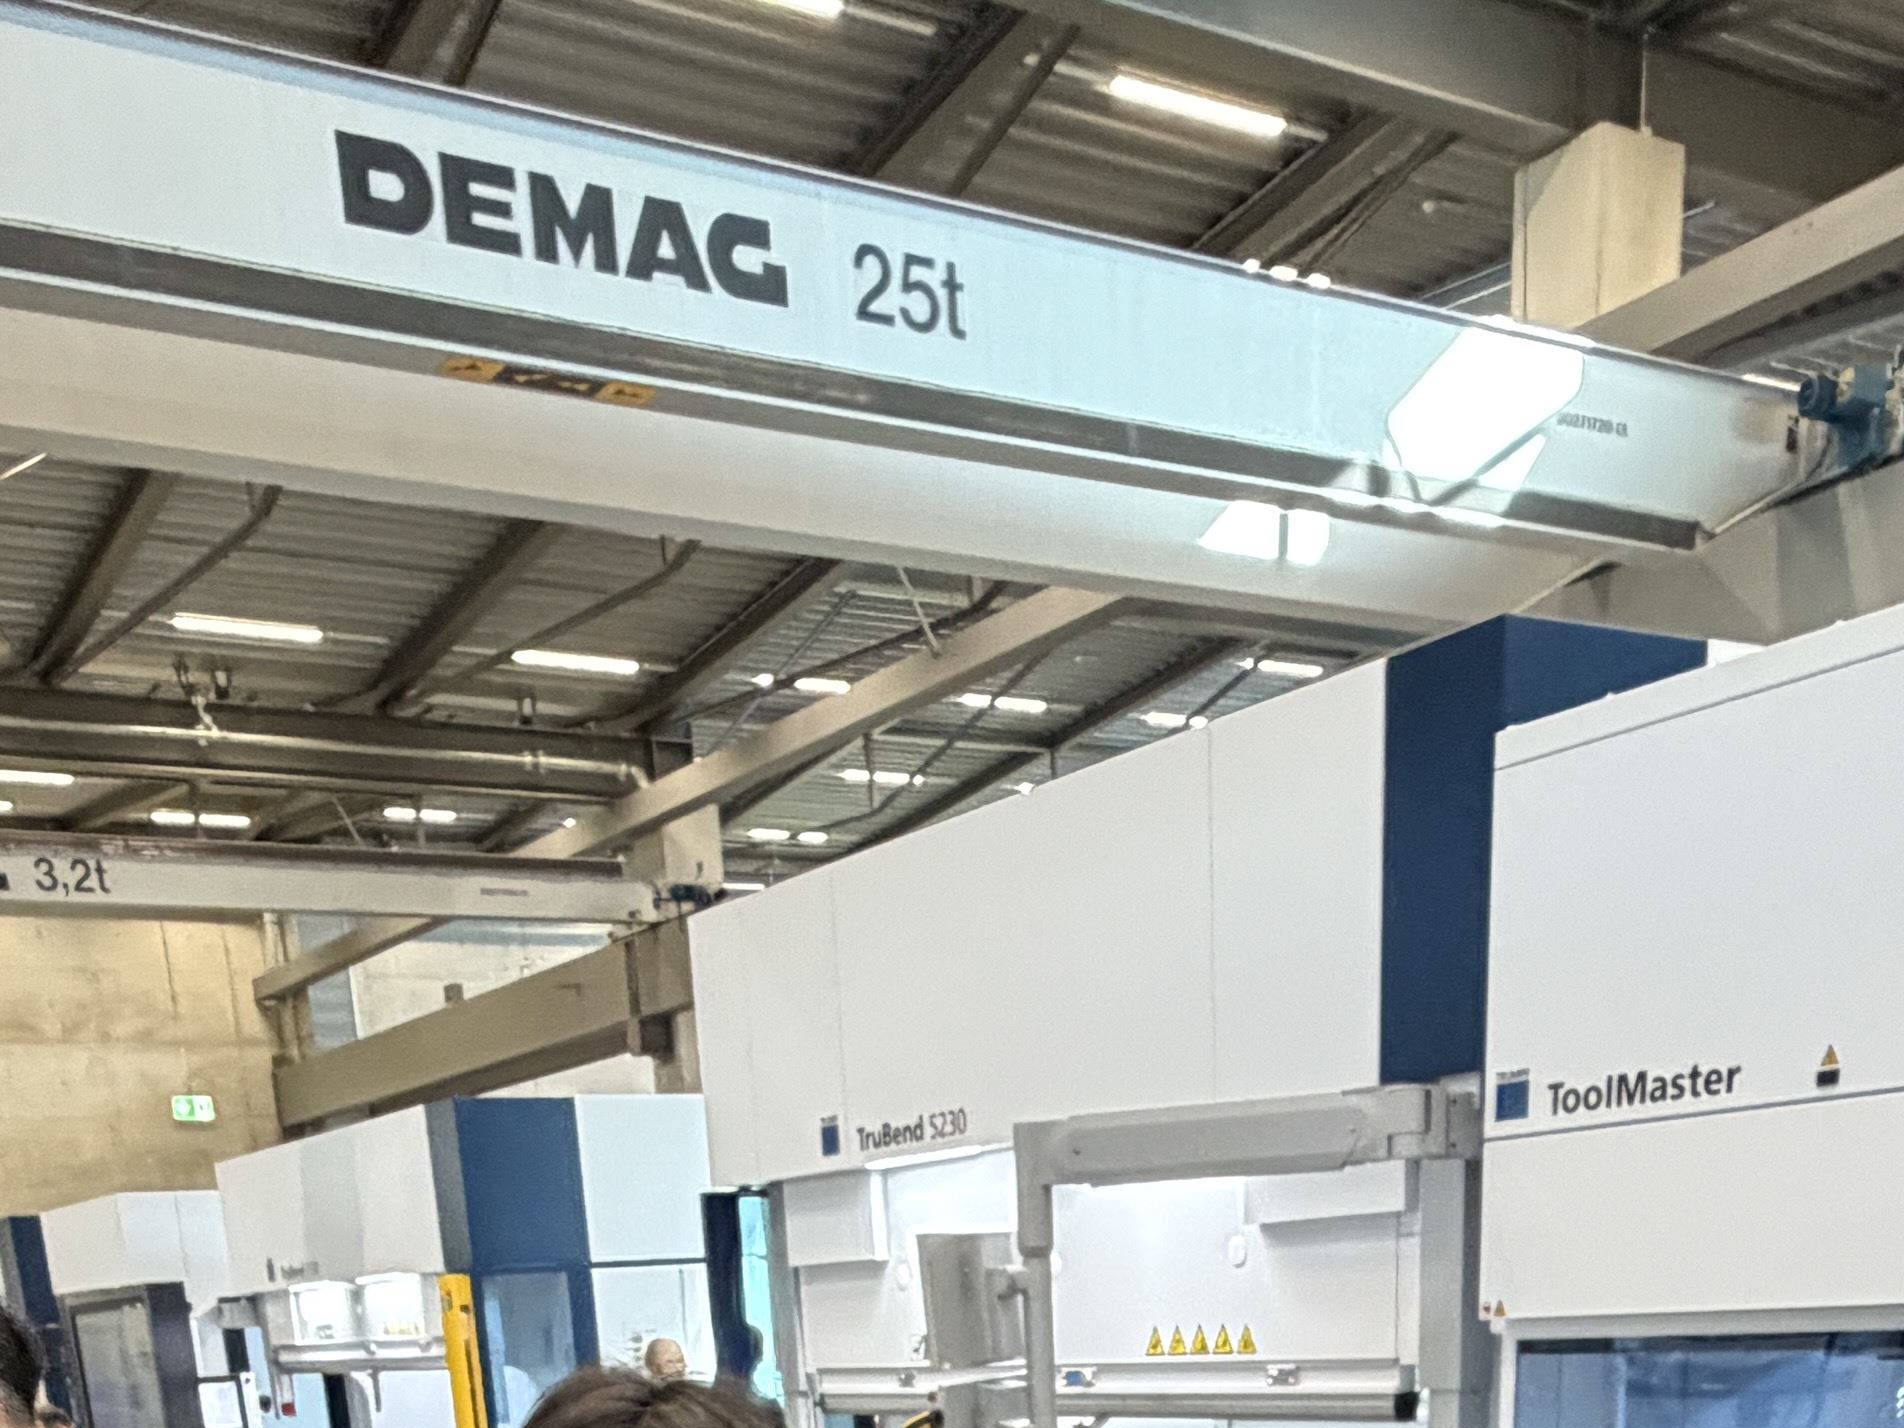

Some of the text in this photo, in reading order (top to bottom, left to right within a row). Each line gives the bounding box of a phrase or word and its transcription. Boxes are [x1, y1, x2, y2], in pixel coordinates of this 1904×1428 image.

[335, 129, 967, 340] DEMAG 25t
[33, 857, 112, 897] 3,2t
[1548, 1064, 1742, 1116] ToolMaster
[856, 1107, 967, 1151] TruBend 5230
